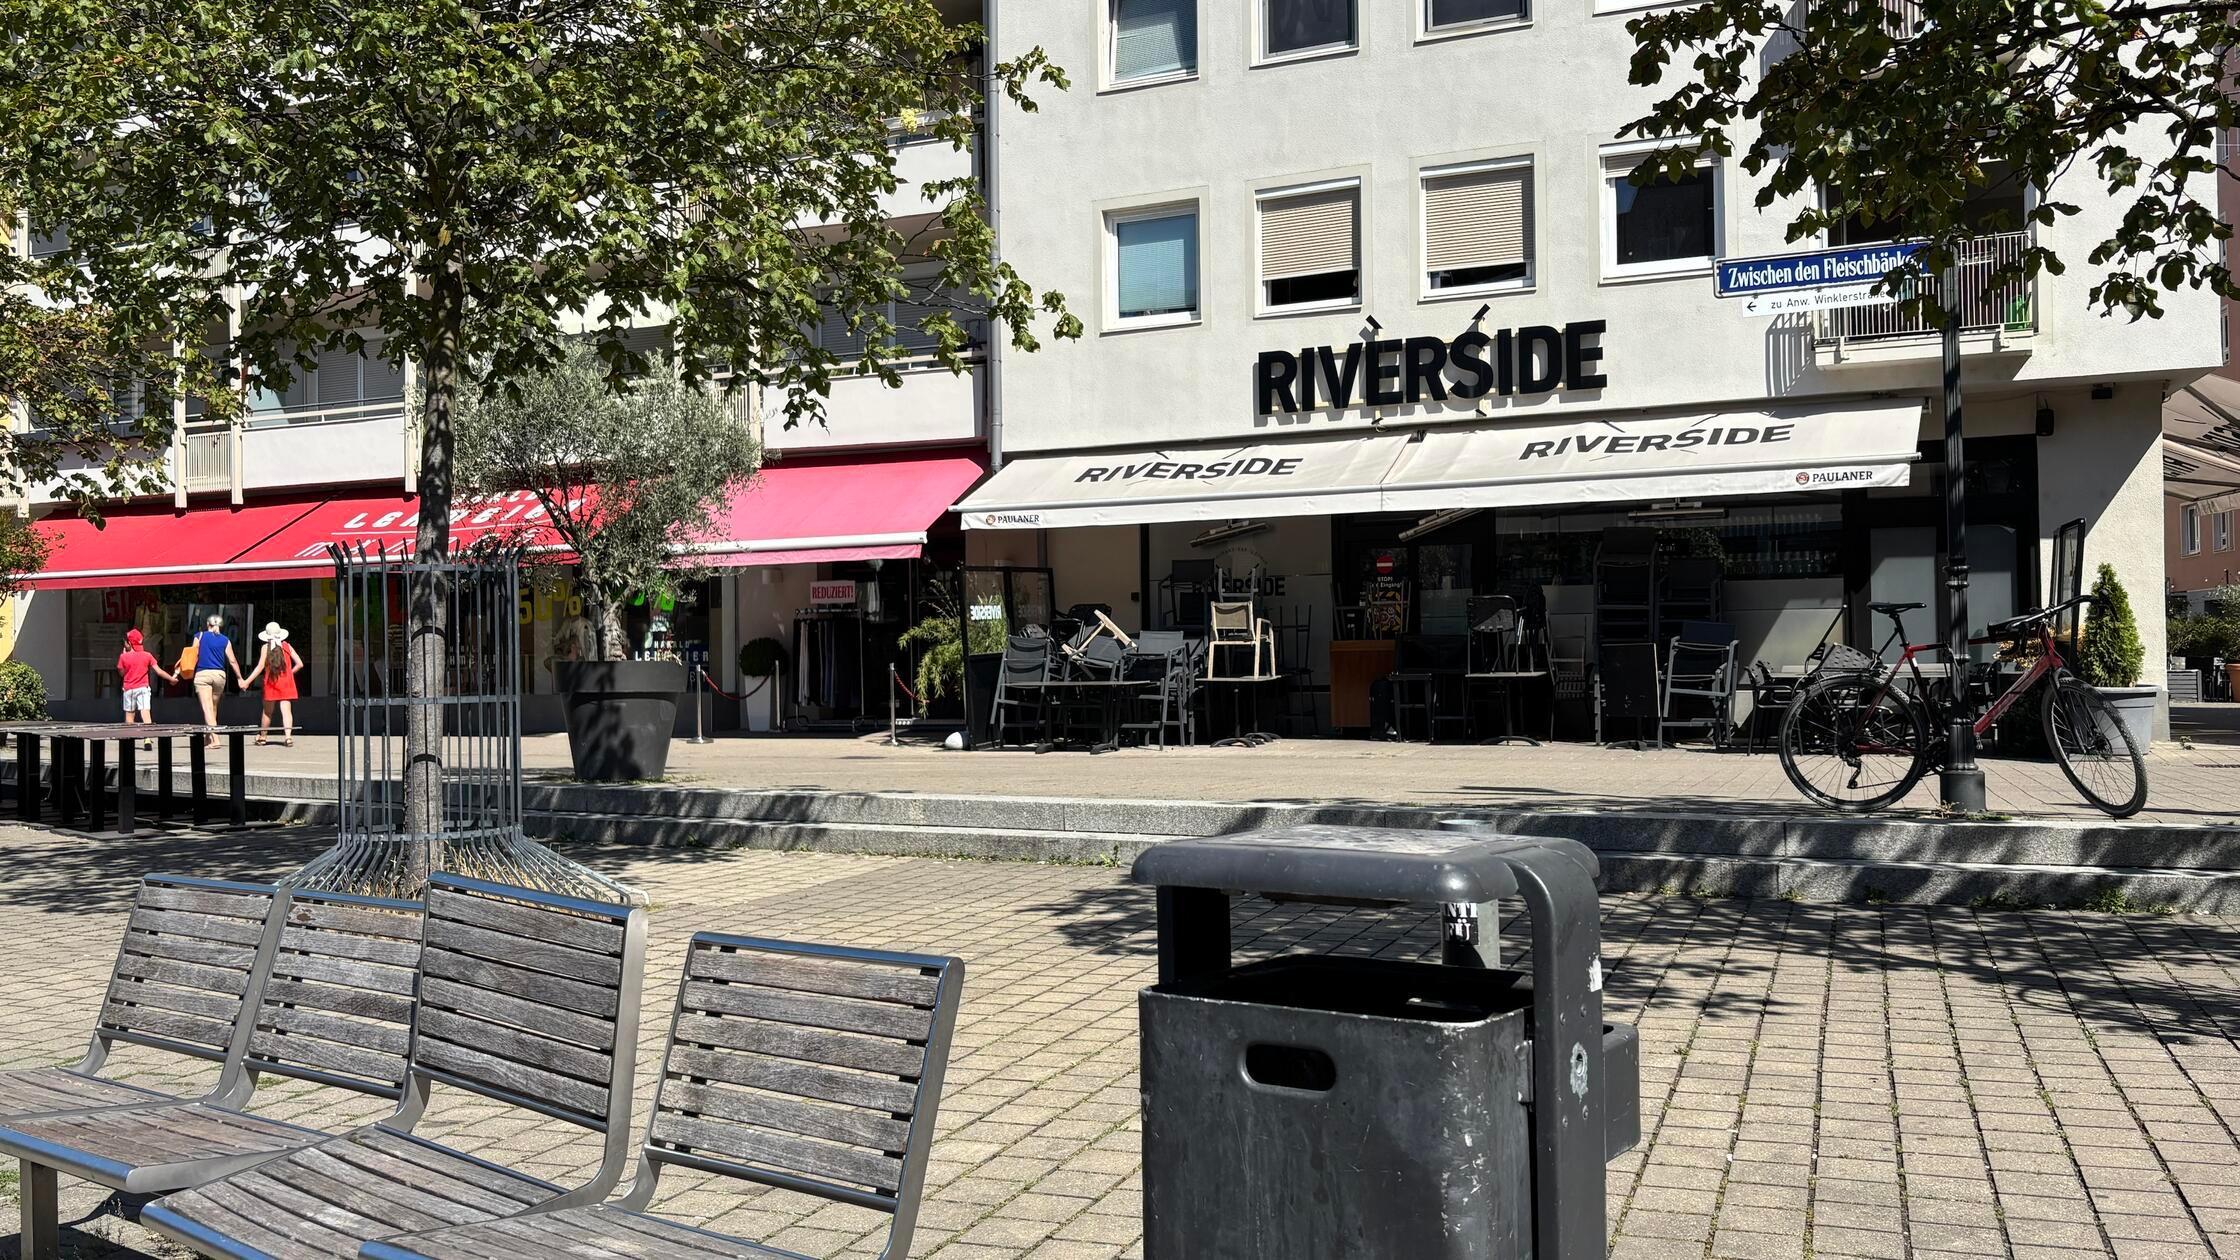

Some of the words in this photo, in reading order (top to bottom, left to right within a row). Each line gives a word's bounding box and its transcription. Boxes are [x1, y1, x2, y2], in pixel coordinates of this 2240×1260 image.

[1728, 264, 1792, 288] Zwischen
[1795, 261, 1820, 281] den
[1787, 298, 1810, 307] Anw.
[1518, 424, 1796, 460] RIVERSIDE
[1074, 457, 1304, 483] RIVERSIDE
[1812, 470, 1873, 483] PAULANER
[997, 513, 1040, 524] PAULANER
[519, 577, 582, 625] 50%
[812, 585, 855, 599] REDUZIERT!
